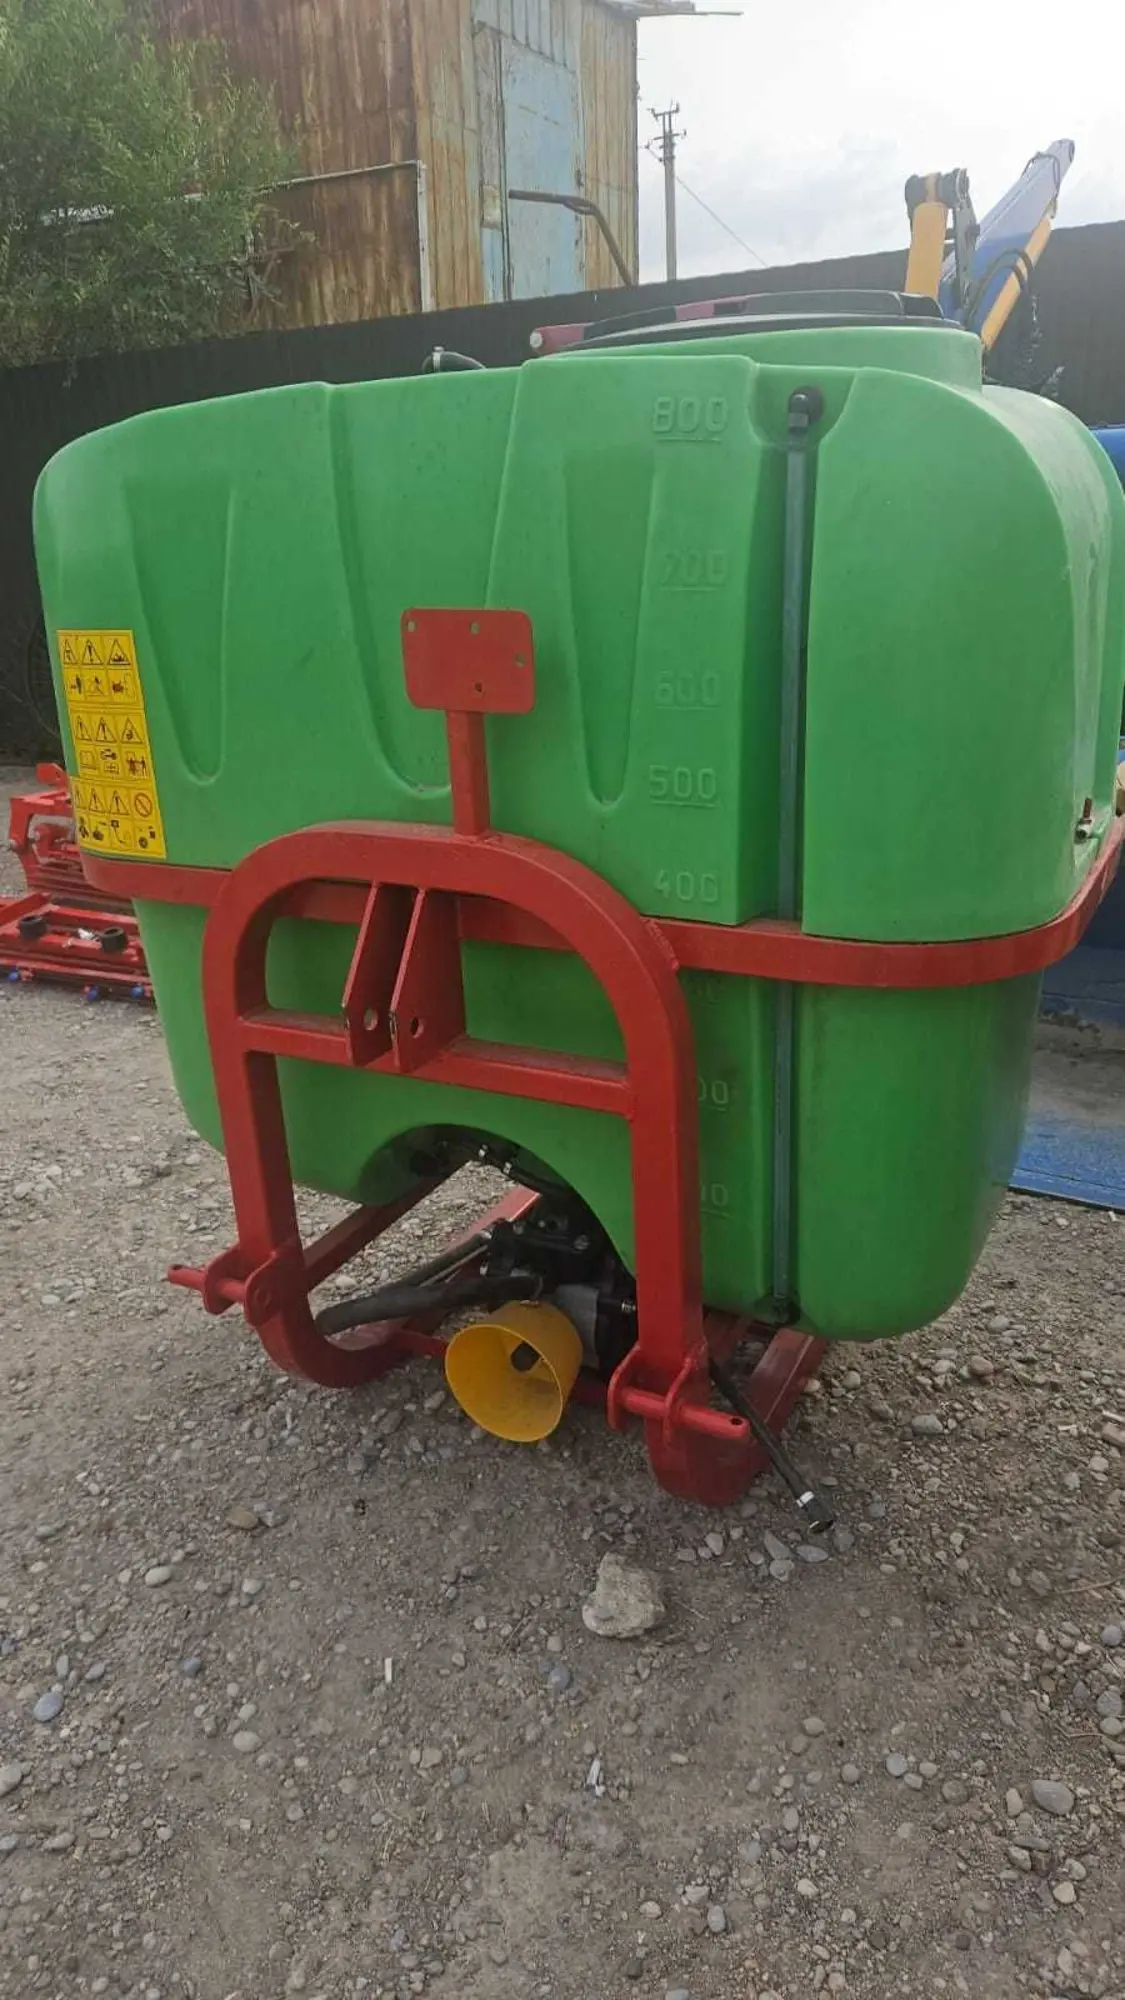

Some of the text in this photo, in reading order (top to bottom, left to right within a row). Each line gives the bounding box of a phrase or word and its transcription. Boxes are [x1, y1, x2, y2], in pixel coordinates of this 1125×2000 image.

[652, 396, 728, 433] 800
[660, 550, 728, 587] 700
[655, 671, 720, 704] 600
[649, 765, 717, 799] 500
[653, 869, 719, 902] 400
